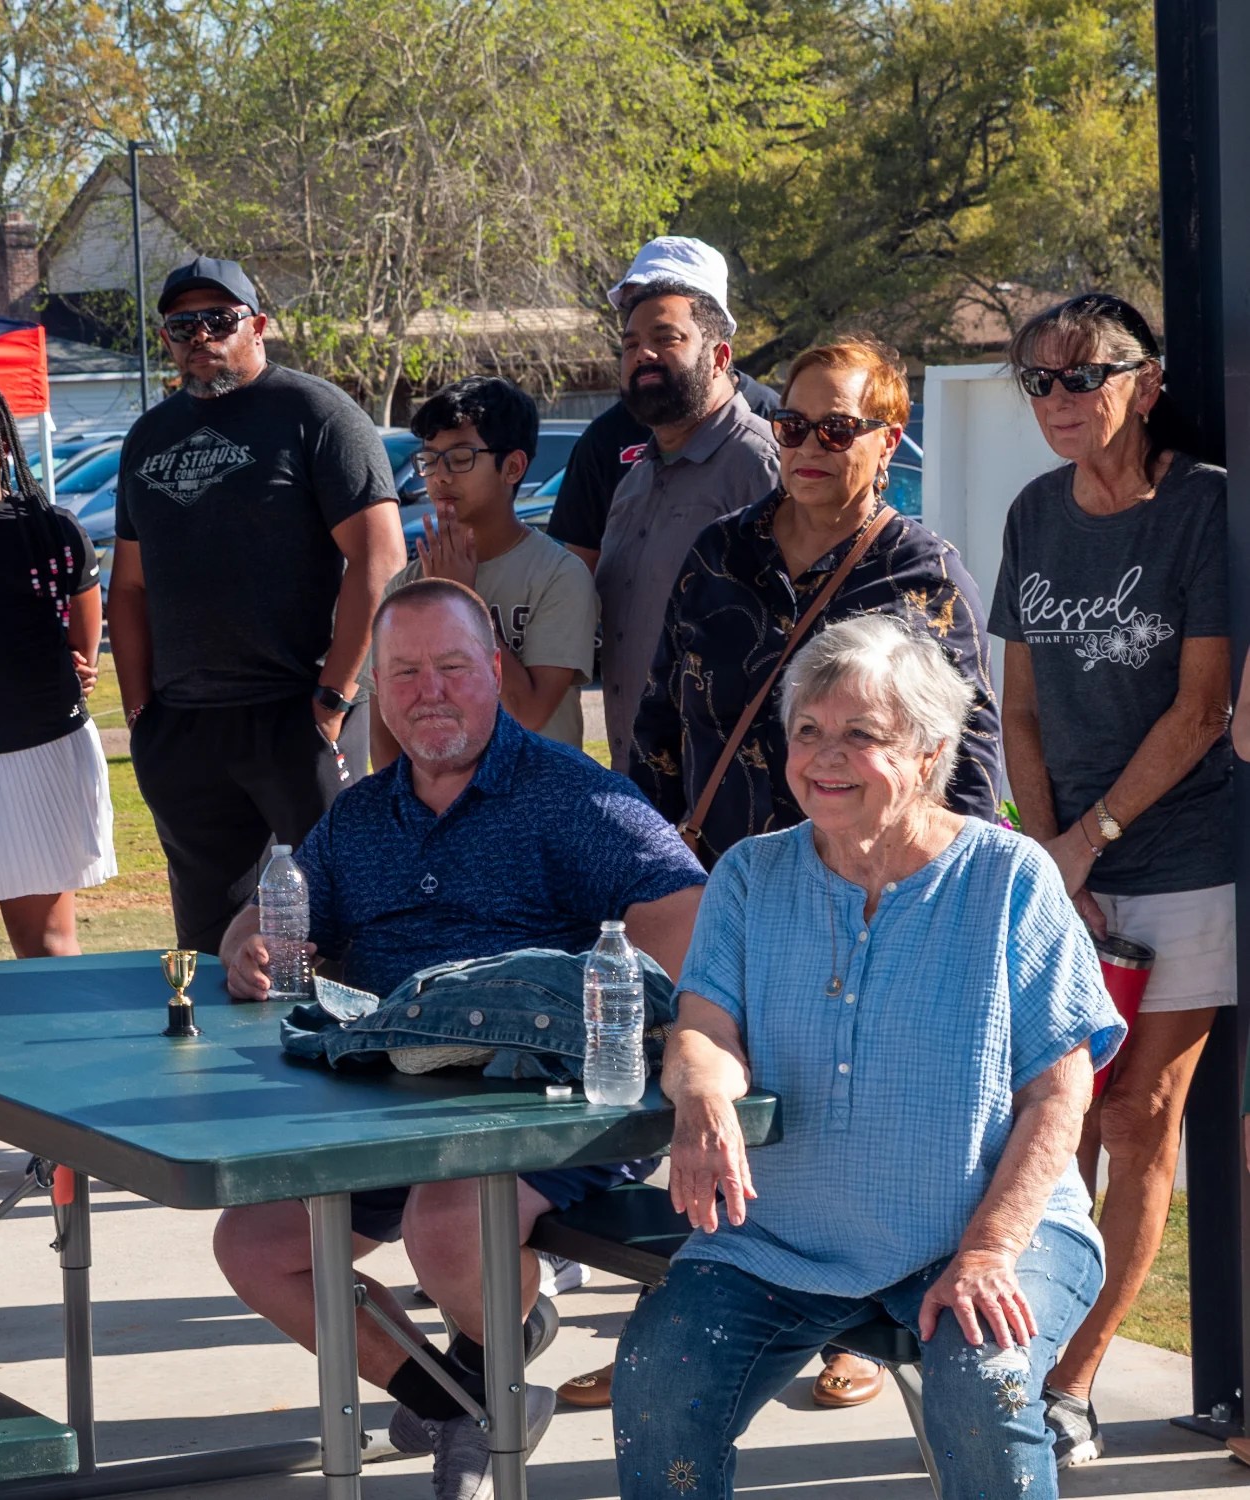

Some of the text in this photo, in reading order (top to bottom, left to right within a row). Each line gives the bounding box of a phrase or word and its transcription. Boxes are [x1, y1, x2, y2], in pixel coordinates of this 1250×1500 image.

[141, 445, 250, 474] LEVI STRAUSS
[1065, 635, 1085, 644] 17:7
